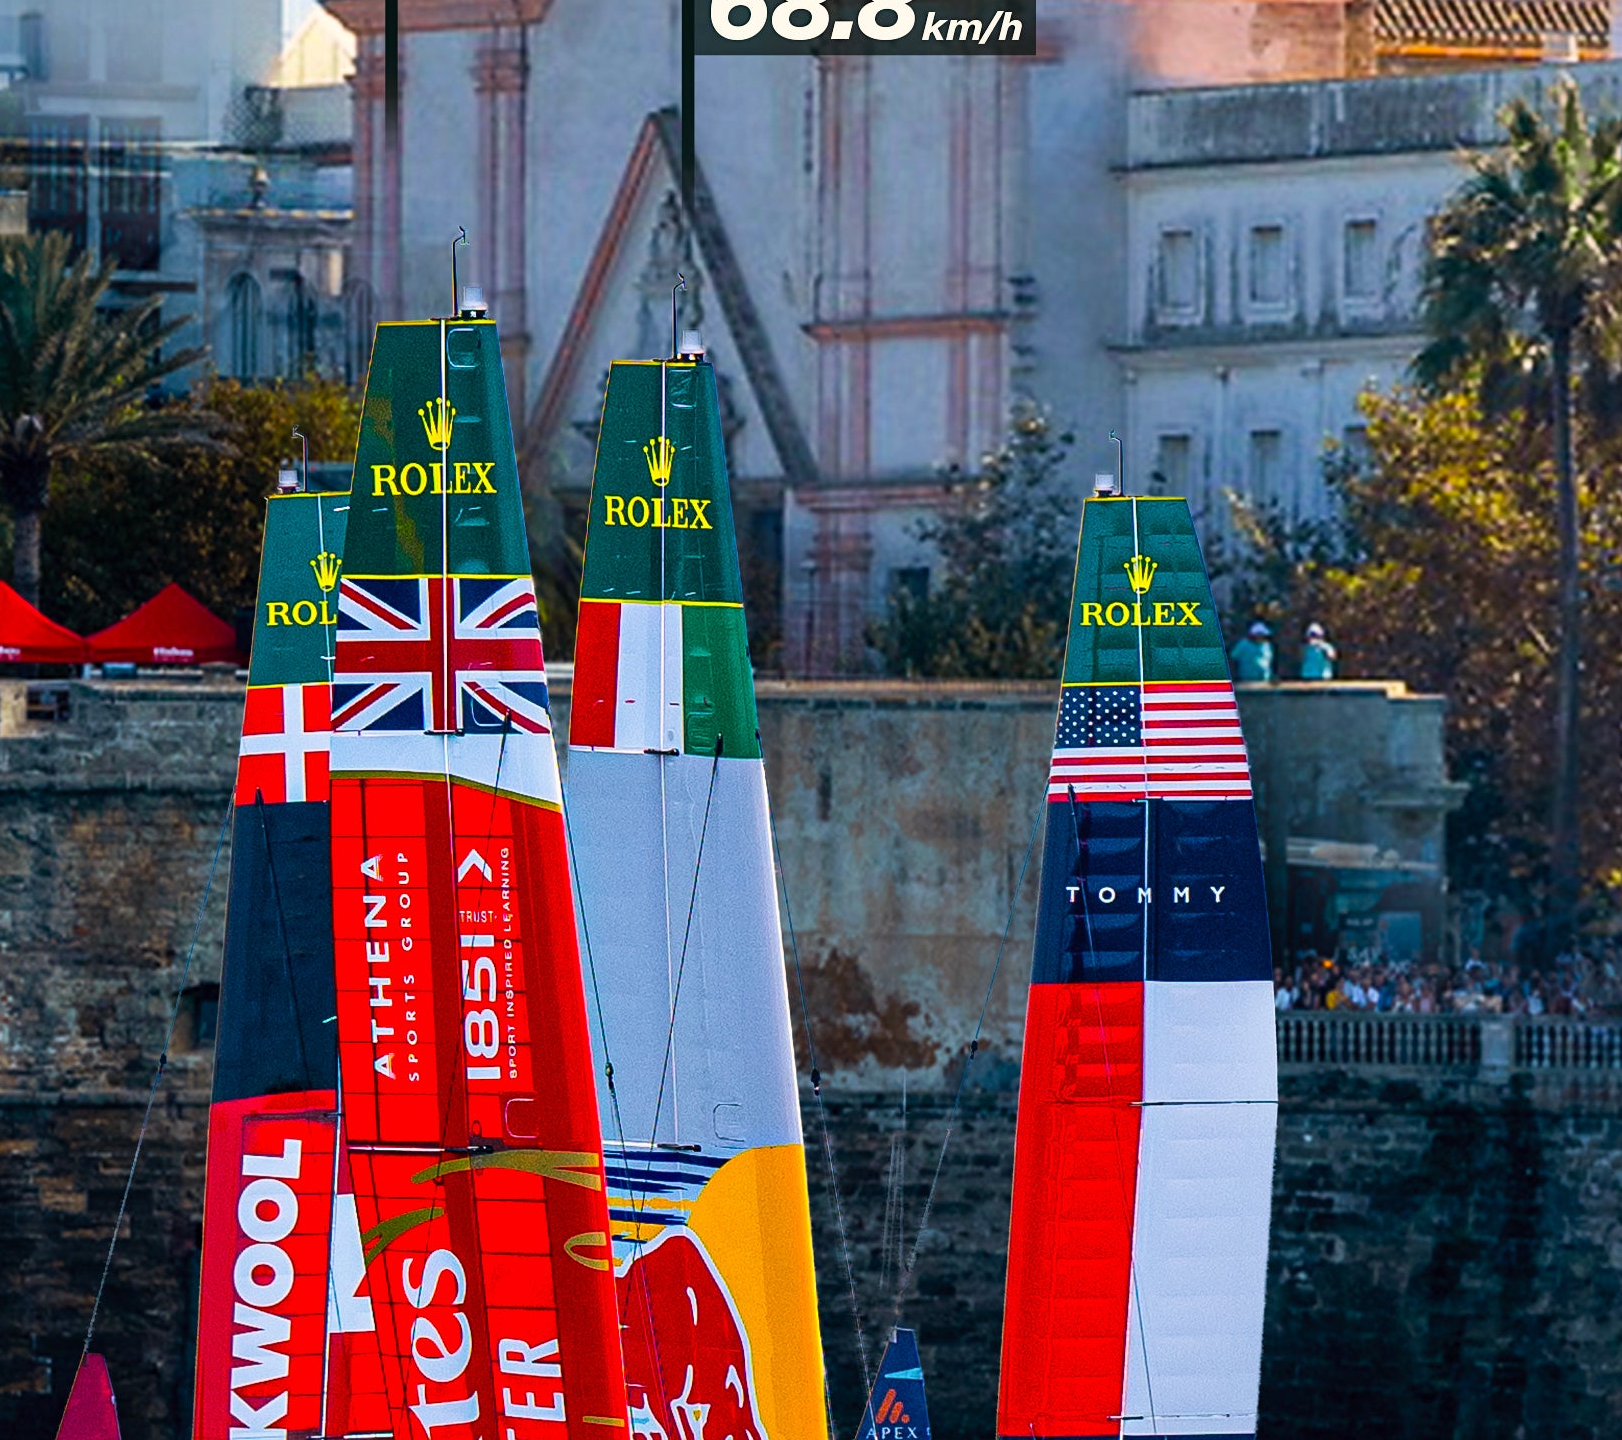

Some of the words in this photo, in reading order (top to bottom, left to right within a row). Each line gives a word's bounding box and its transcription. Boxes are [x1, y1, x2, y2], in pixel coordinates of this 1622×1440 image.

[371, 461, 497, 497] ROLEX
[604, 494, 712, 530] ROLEX
[267, 600, 337, 626] ROL
[1080, 602, 1202, 627] ROLEX
[398, 853, 413, 951] GROUP
[501, 847, 513, 932] LEARNING
[1066, 885, 1226, 904] TOMMY
[459, 911, 494, 923] TRUST
[361, 854, 396, 1080] ATHENA
[504, 939, 515, 1017] INSPIRED
[404, 975, 419, 1081] SPORTS
[508, 1025, 518, 1078] SPORT
[866, 1427, 918, 1439] APEX
